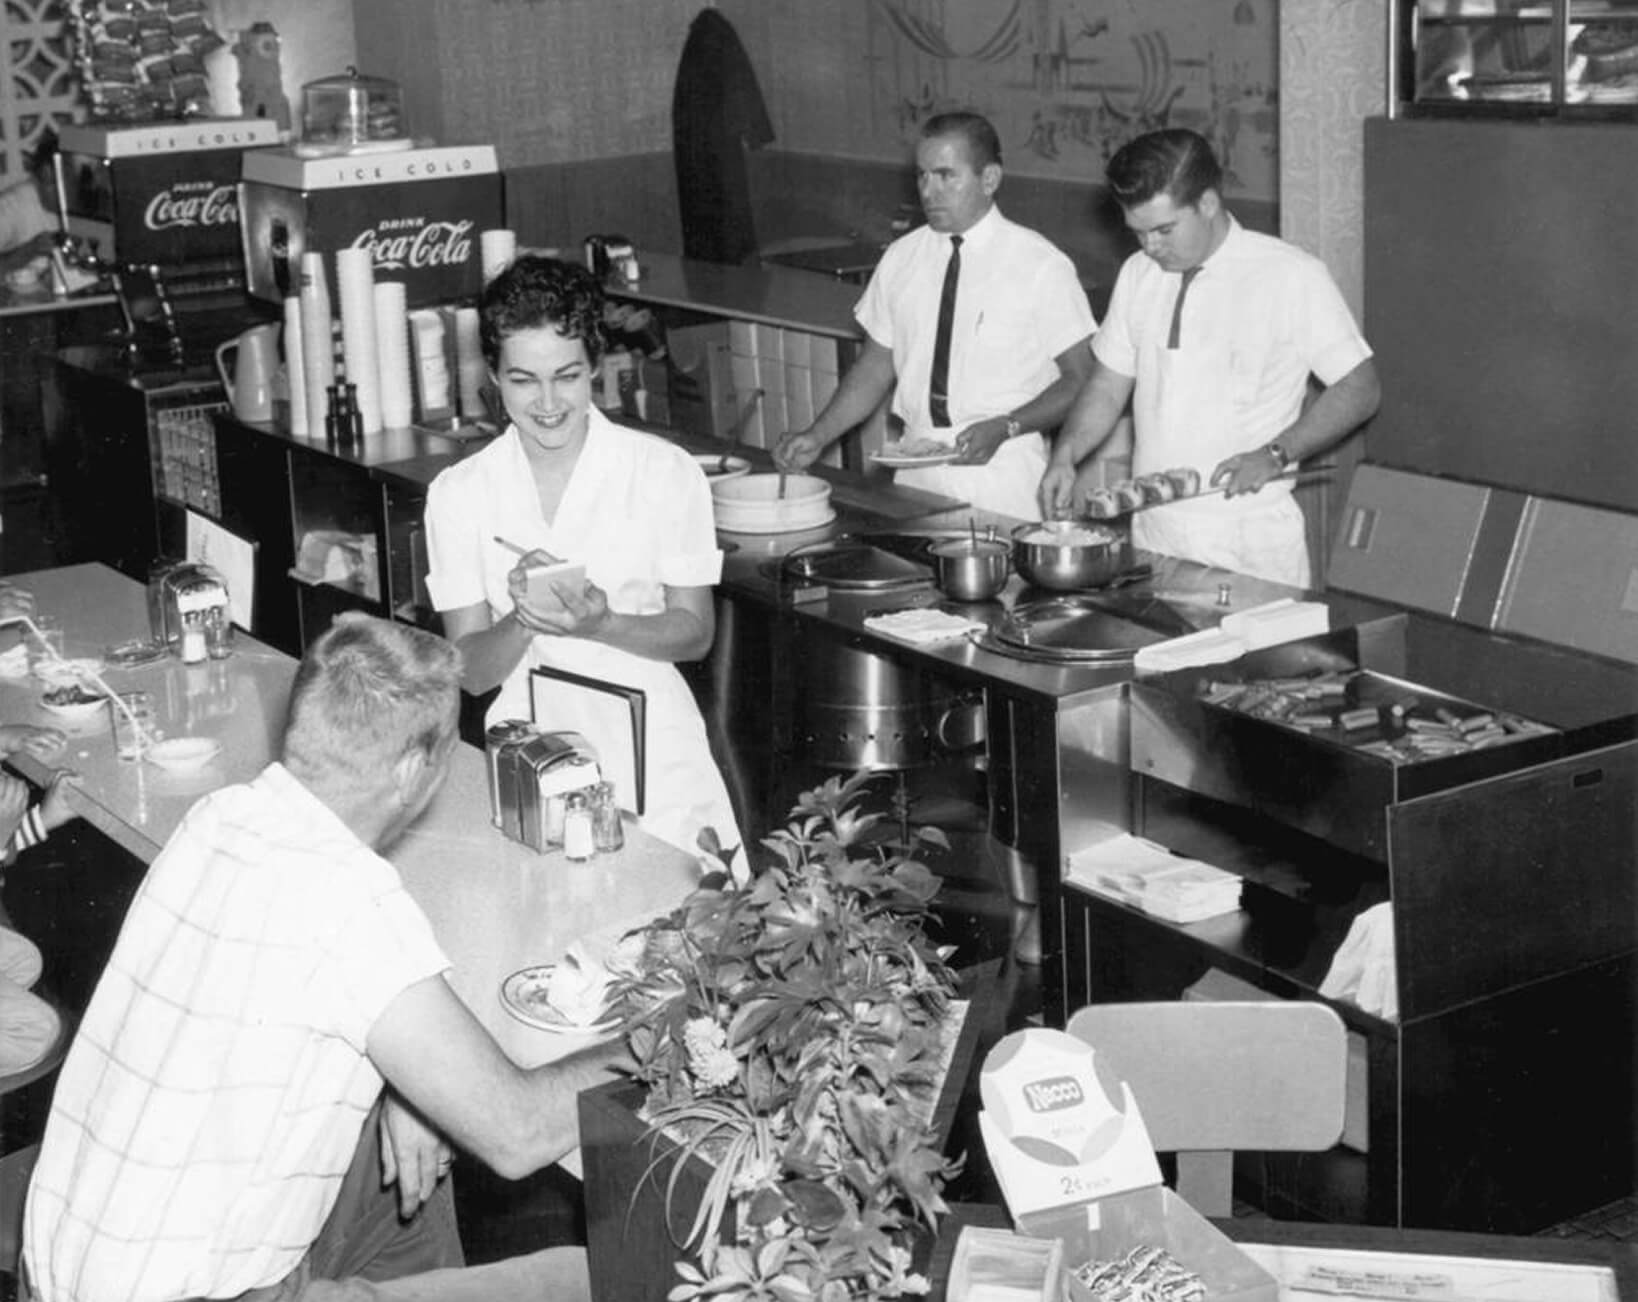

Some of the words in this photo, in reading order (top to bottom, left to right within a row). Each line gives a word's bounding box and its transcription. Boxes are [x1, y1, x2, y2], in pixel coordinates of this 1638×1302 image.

[338, 167, 382, 181] ICE
[407, 159, 472, 175] COLD
[378, 216, 425, 231] DRINK
[1026, 1081, 1081, 1111] Necco
